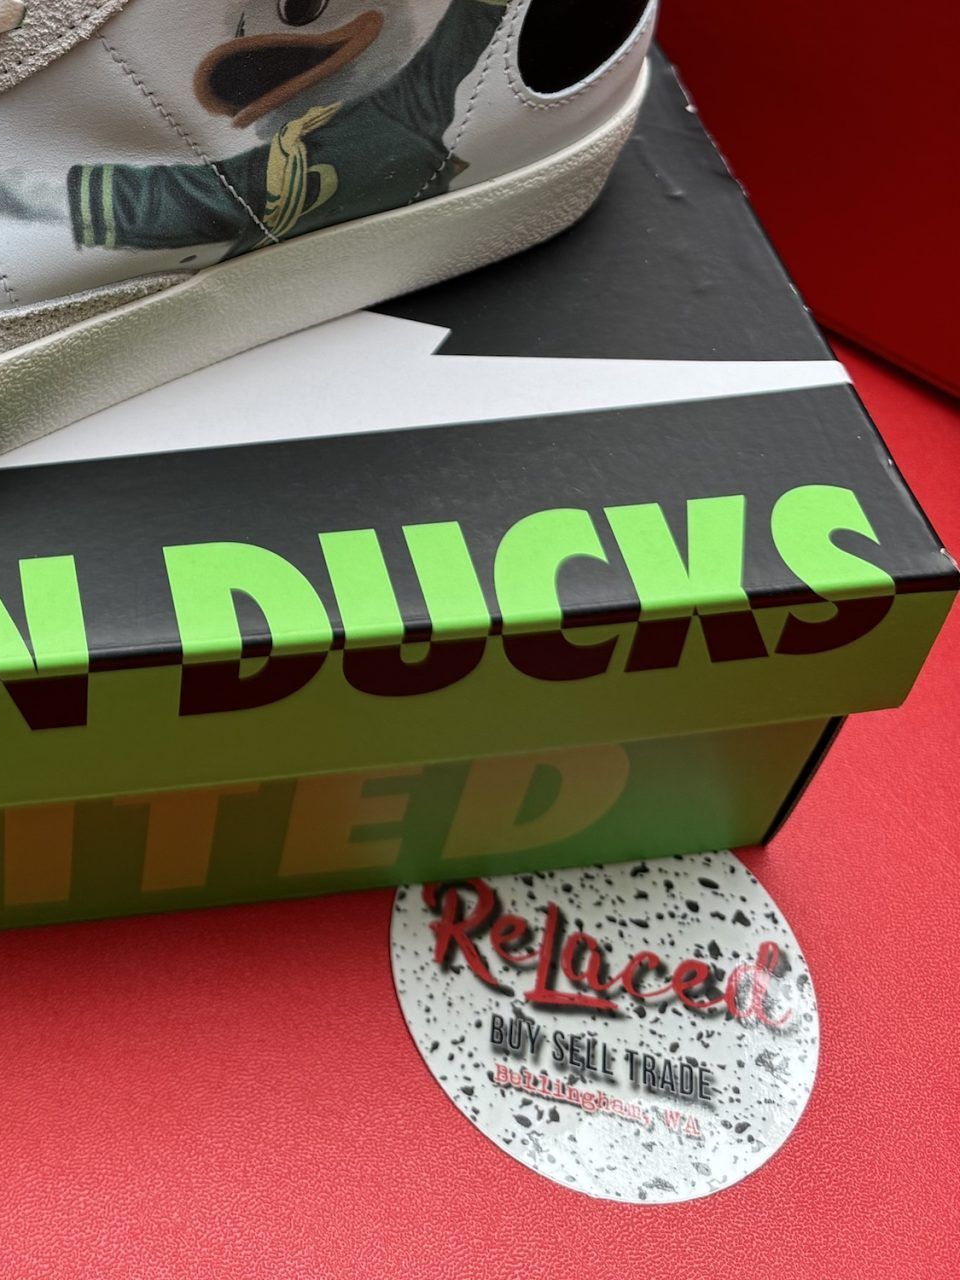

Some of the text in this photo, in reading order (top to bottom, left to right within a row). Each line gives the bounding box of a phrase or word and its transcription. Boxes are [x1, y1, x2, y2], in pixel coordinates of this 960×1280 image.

[163, 484, 896, 717] DUCKS
[422, 877, 792, 1028] ReLaced
[490, 1014, 713, 1100] BUY SELL TRADE
[494, 1063, 702, 1136] Bellingham, WA
